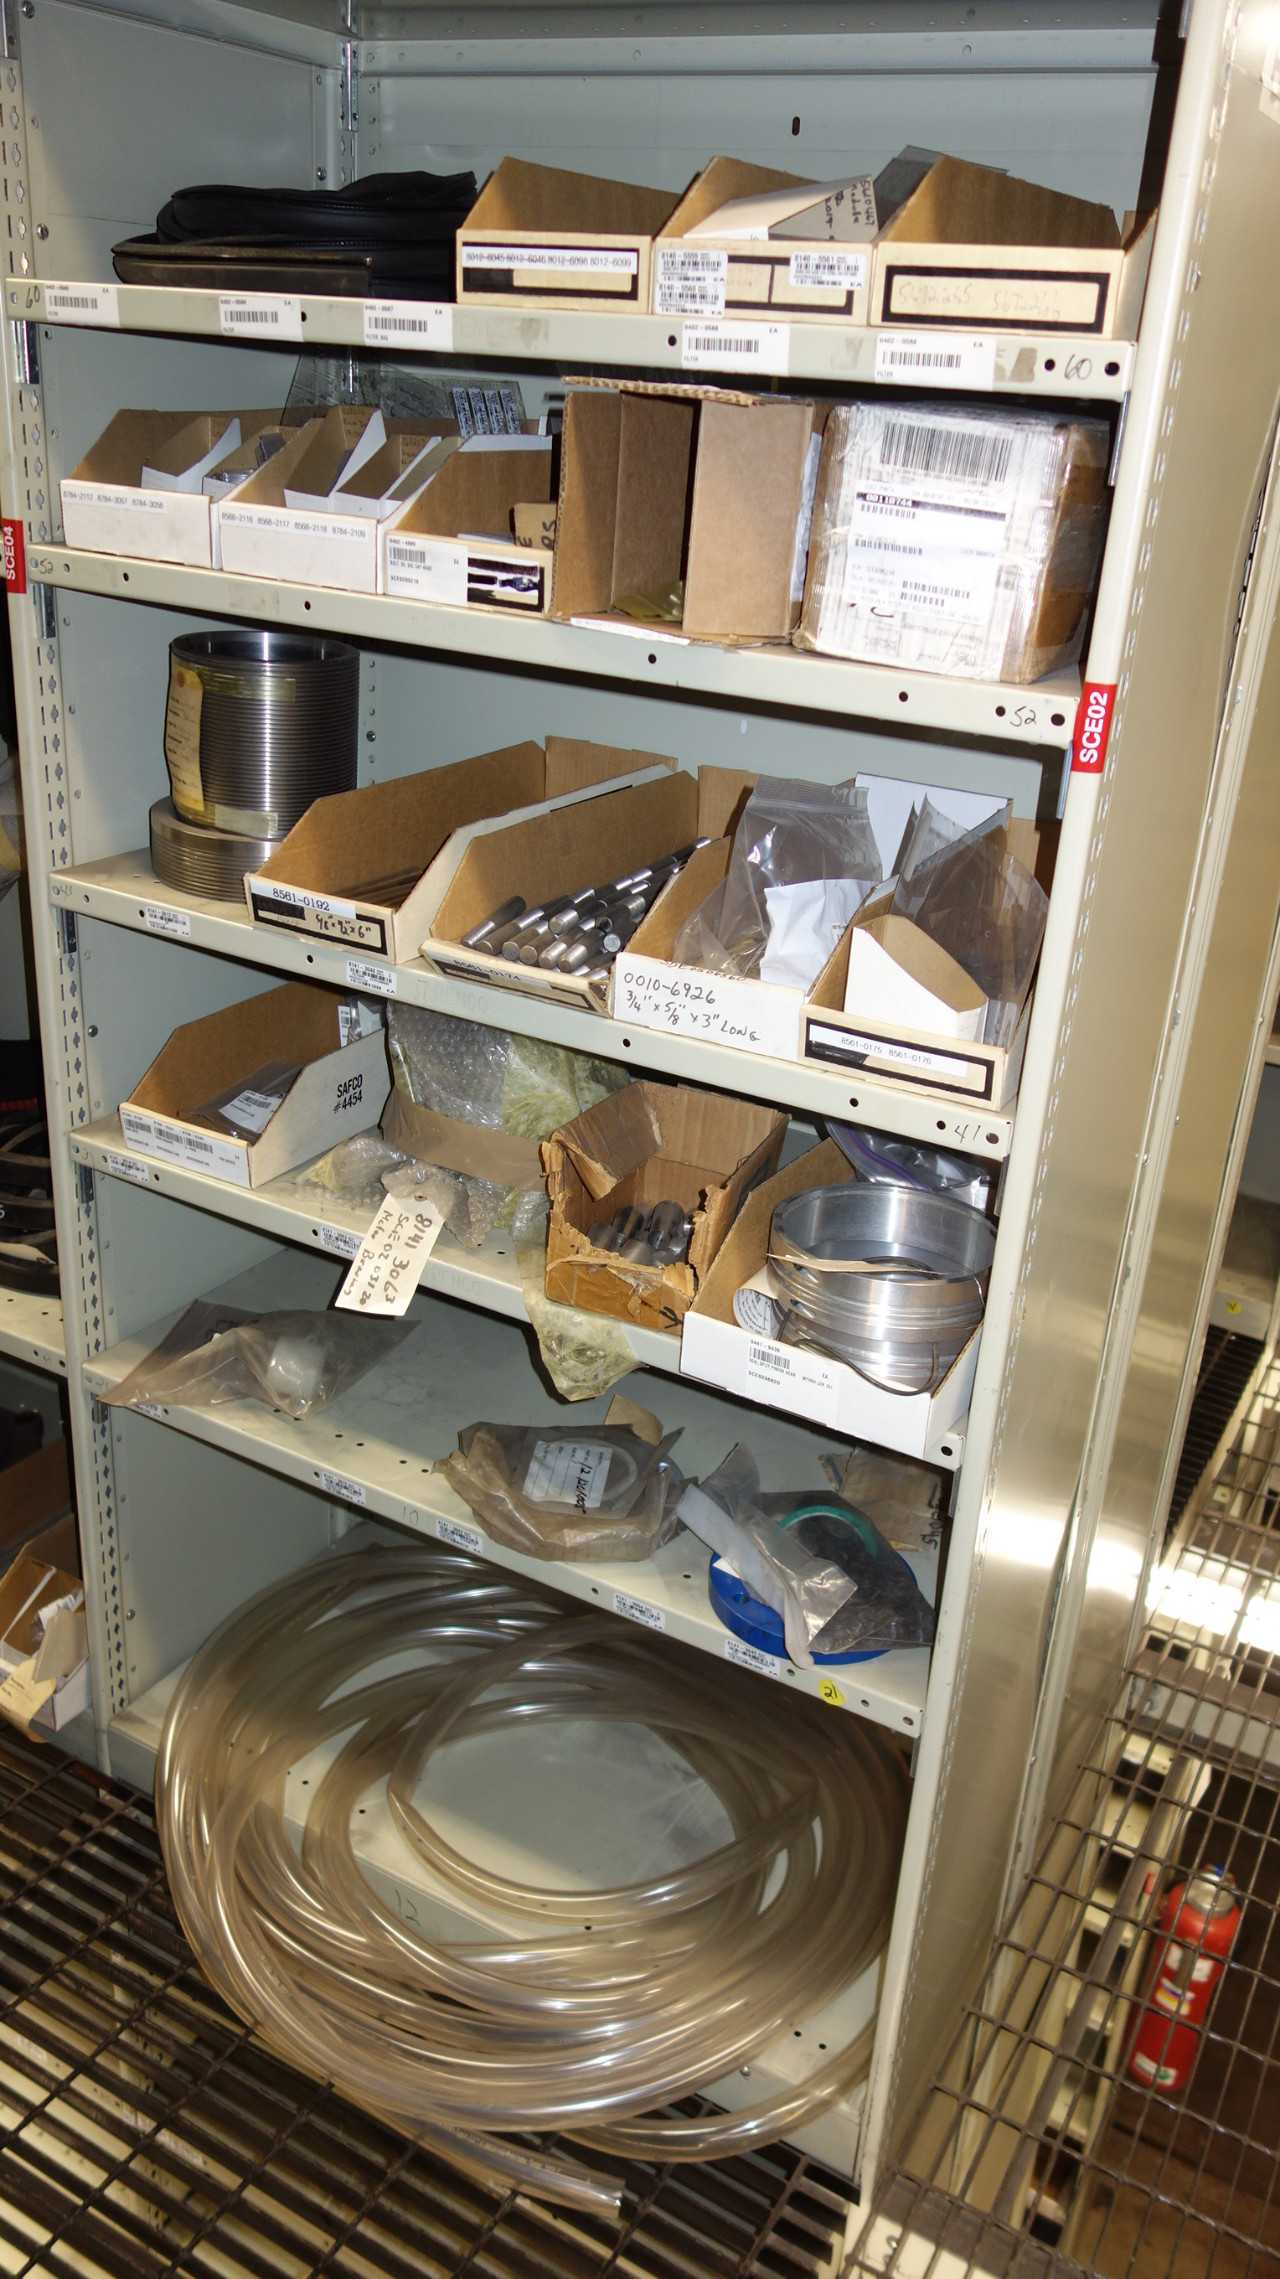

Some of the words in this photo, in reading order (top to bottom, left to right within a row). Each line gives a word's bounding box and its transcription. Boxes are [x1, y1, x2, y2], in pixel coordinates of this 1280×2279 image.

[1063, 353, 1093, 381] 60
[3, 525, 15, 581] SCE04
[1009, 705, 1038, 728] 52
[1079, 691, 1109, 764] SCE02
[623, 972, 717, 1005] 0010-6926
[701, 1013, 720, 1029] 3"
[720, 1019, 761, 1042] LONG
[337, 1073, 363, 1099] SAFCO
[333, 1089, 363, 1115] #4454
[954, 1123, 981, 1145] 41
[404, 1213, 433, 1249] 8141
[382, 1255, 411, 1304] 3063
[823, 1683, 839, 1699] 21
